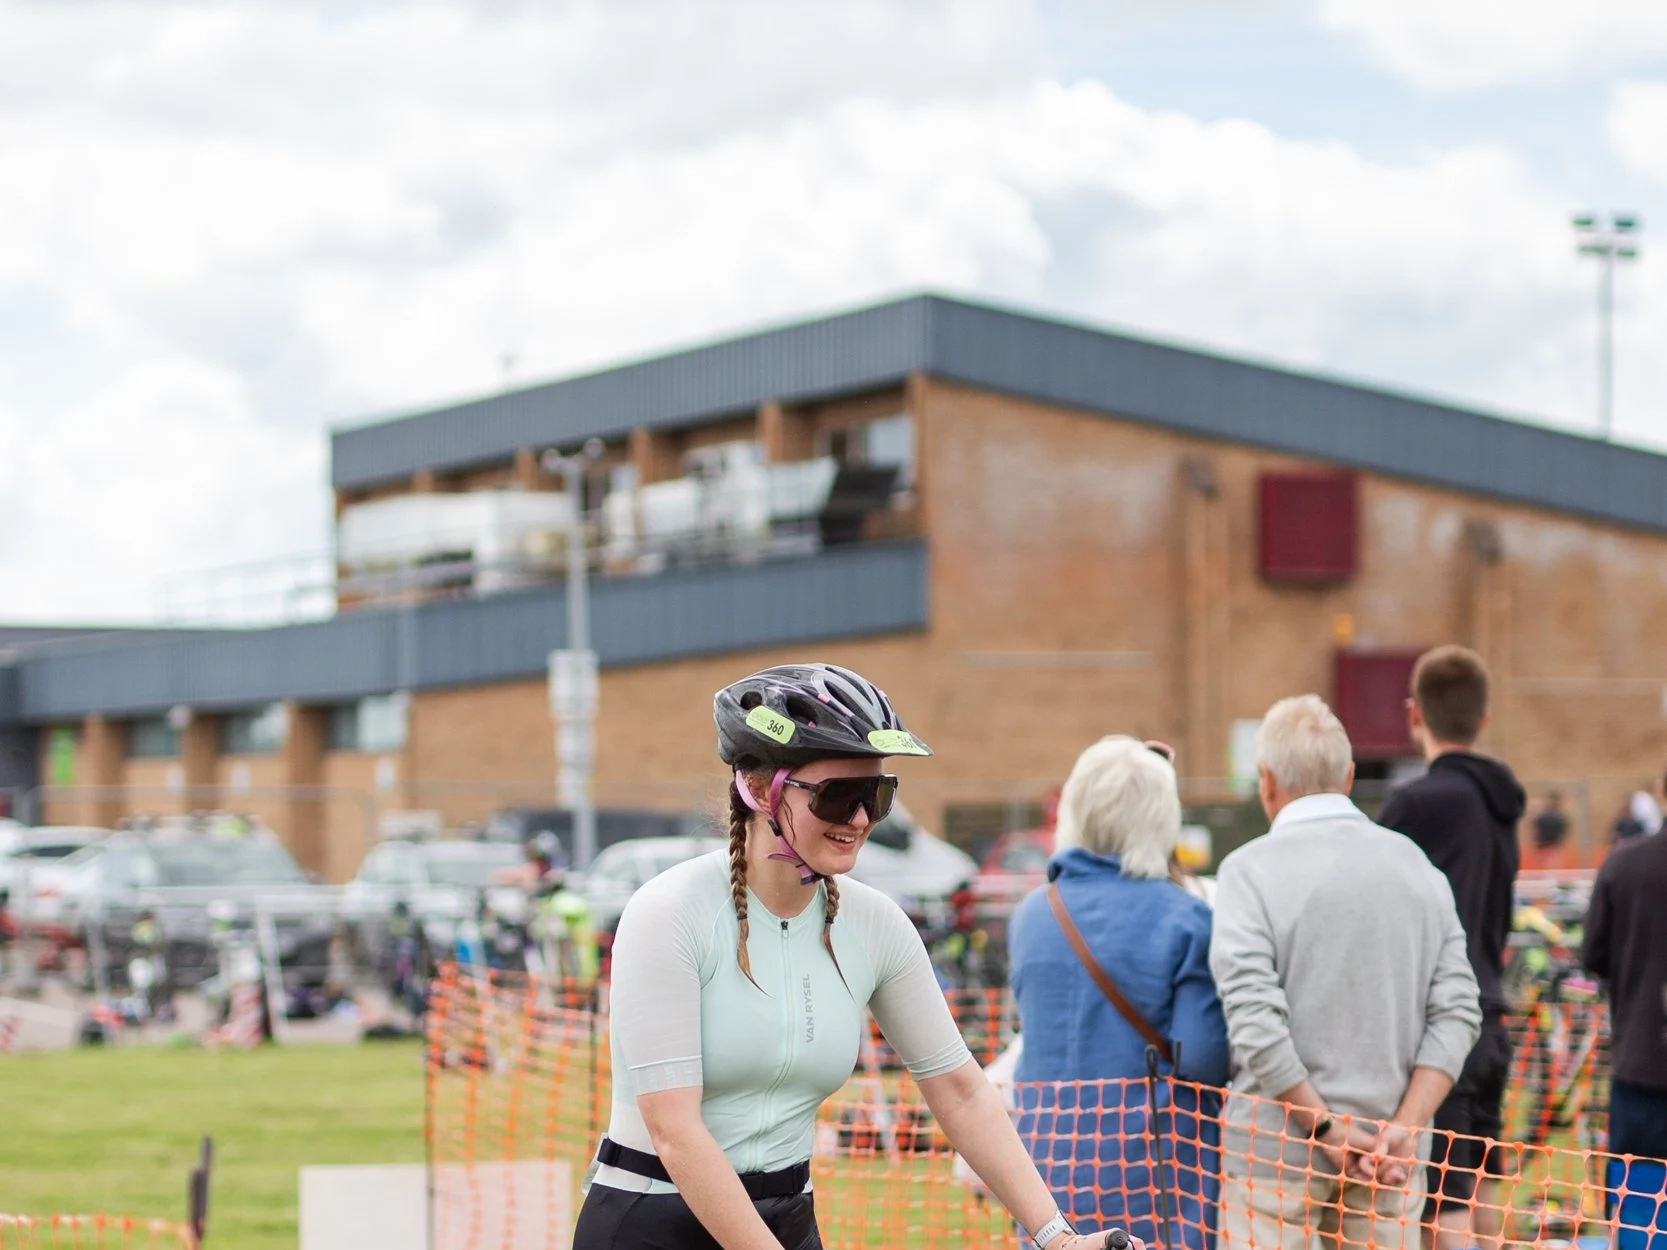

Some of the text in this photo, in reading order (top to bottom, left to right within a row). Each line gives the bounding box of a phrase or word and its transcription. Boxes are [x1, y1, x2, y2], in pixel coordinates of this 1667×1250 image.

[767, 719, 785, 736] 360
[802, 974, 815, 1043] VAN RYSEL
